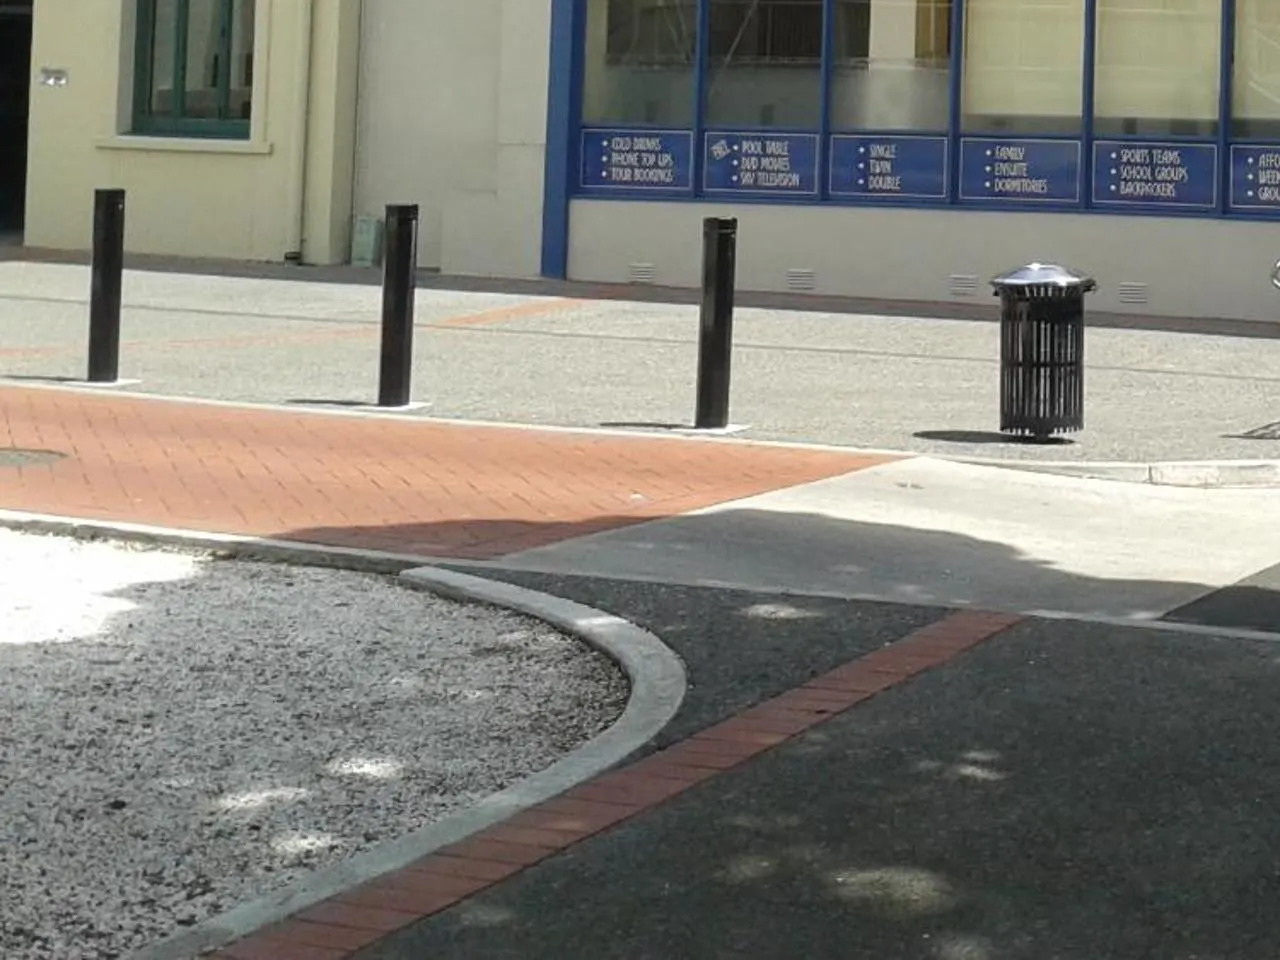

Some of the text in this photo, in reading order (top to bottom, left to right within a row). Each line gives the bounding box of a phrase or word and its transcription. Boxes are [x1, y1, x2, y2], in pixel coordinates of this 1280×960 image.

[741, 140, 762, 155] POOL
[766, 140, 789, 155] TABLE
[869, 144, 897, 159] SINGLE
[995, 145, 1025, 160] FAMILY
[612, 152, 639, 166] PHONE
[741, 155, 759, 170] DVD
[1120, 148, 1181, 165] SPORTS TEAMS
[869, 159, 891, 174] TWIN
[995, 161, 1028, 177] ENSUITE
[1120, 164, 1189, 183] SCHOOL GROUPS
[612, 167, 674, 183] TOUR BOOKINGS
[757, 171, 800, 187] TELEVISION
[868, 174, 901, 190] DOUBLE
[994, 177, 1047, 194] DORMITORIES
[1120, 180, 1176, 198] BACKPACKERS
